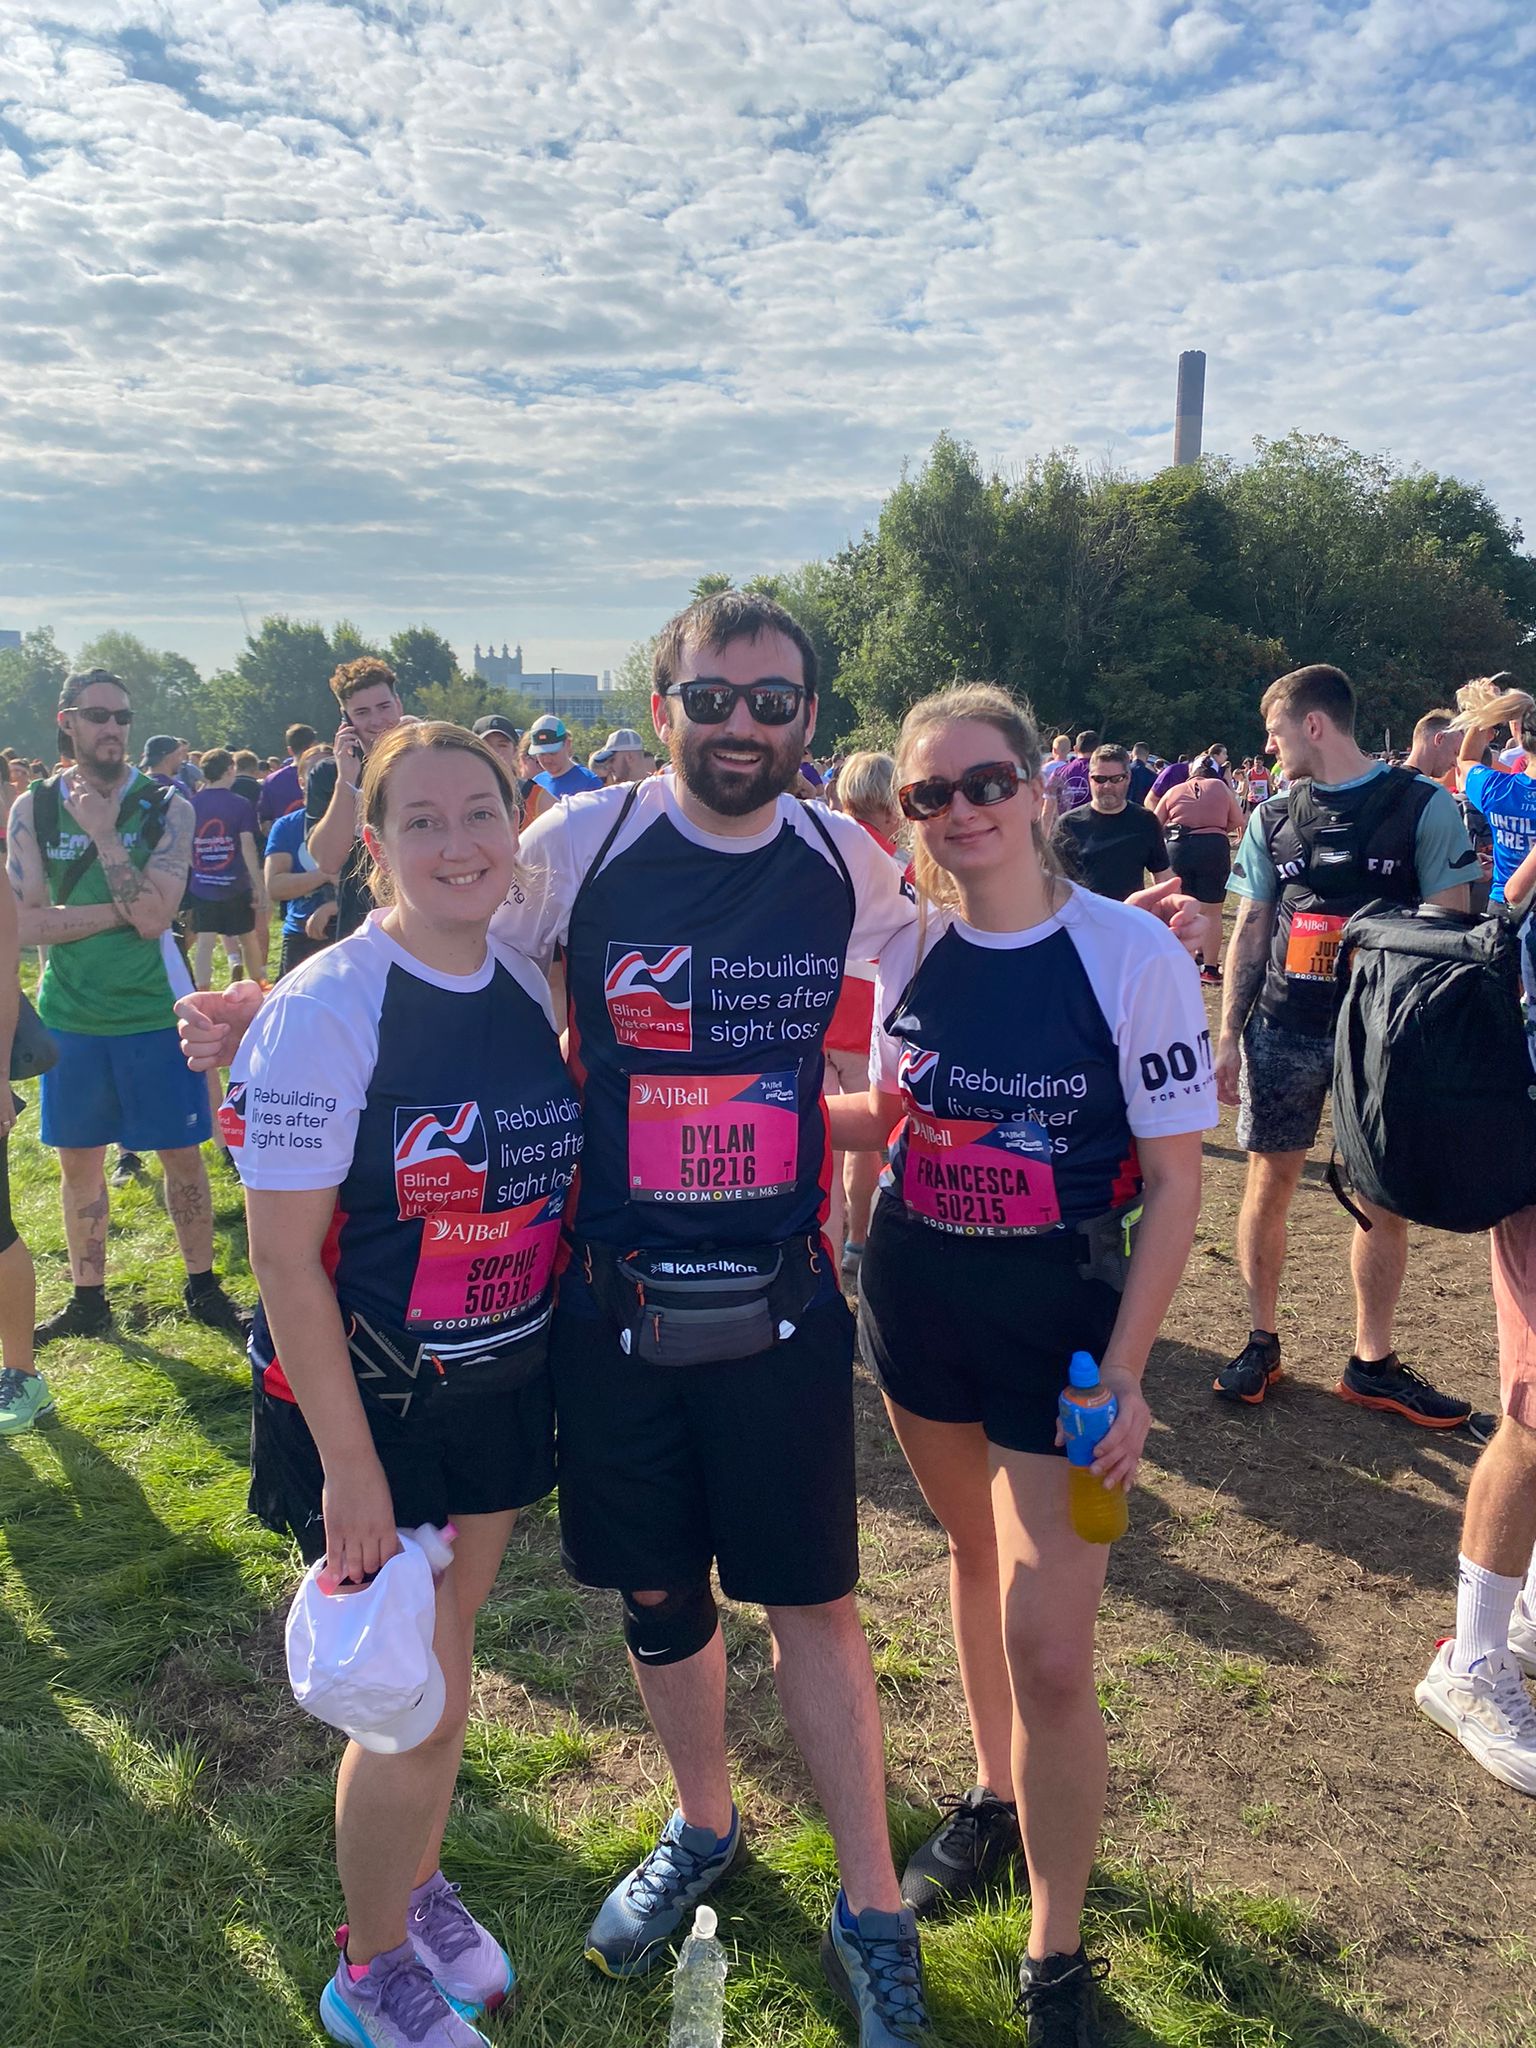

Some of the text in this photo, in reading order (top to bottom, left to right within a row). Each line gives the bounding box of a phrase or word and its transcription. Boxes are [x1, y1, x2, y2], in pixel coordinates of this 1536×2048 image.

[1489, 811, 1536, 834] UNTIL
[1497, 829, 1525, 850] ARE
[711, 953, 838, 980] Rebuilding
[711, 986, 834, 1011] lives after
[612, 1004, 651, 1018] Blind
[617, 1017, 685, 1032] Veterans
[619, 1029, 639, 1043] UK
[711, 1018, 820, 1048] sight loss
[1139, 1041, 1197, 1091] DO
[950, 1065, 1087, 1099] Rebuilding
[254, 1087, 337, 1113] Rebuilding
[948, 1097, 1004, 1120] lives
[1150, 1091, 1176, 1103] FOR
[252, 1107, 328, 1128] lives after
[494, 1097, 583, 1133] Rebuildin
[251, 1129, 323, 1149] sight loss
[500, 1132, 584, 1169] lives afte
[681, 1123, 755, 1155] DYLAN
[403, 1173, 450, 1187] Blind
[680, 1155, 756, 1188] 50216
[917, 1156, 1031, 1196] FRANCESCA
[403, 1187, 479, 1203] Veterans
[497, 1172, 548, 1206] sight
[654, 1189, 742, 1201] GOODMOVE
[759, 1186, 779, 1197] M&S
[406, 1203, 428, 1217] UK
[935, 1192, 1007, 1224] 50215
[922, 1216, 995, 1236] GOODMOVE
[1013, 1227, 1037, 1236] M&S
[467, 1242, 541, 1282] SOPHIE
[676, 1260, 758, 1274] KARRIMOR
[464, 1274, 532, 1315] 50316
[433, 1307, 517, 1330] GOODMOVE
